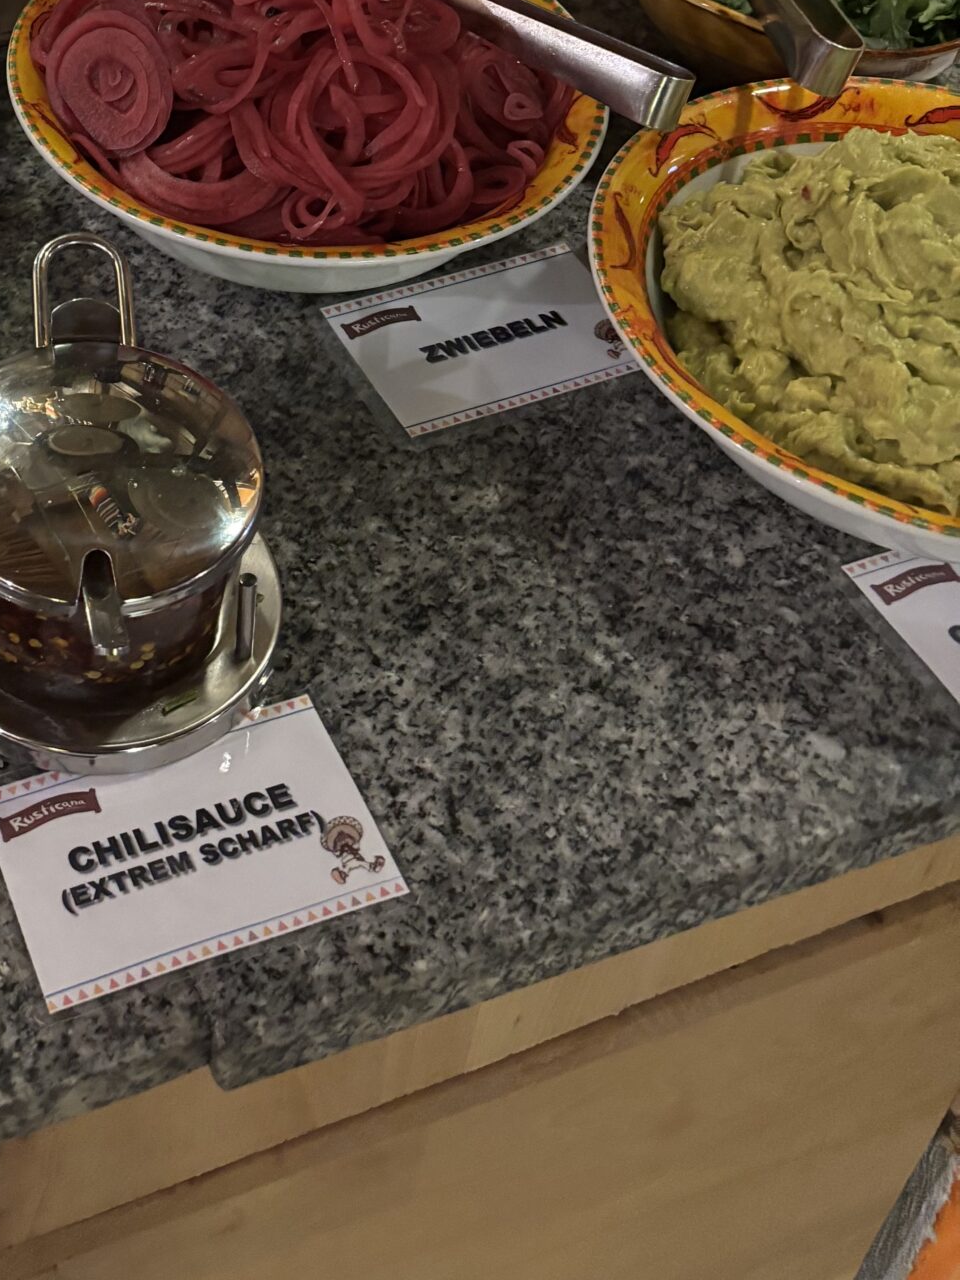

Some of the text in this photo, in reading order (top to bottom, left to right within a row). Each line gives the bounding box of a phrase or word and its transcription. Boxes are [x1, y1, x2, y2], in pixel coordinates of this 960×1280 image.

[418, 310, 569, 365] ZWIEBELN
[7, 798, 87, 833] Rusticana
[67, 783, 299, 874] CHILISAUCE
[61, 810, 326, 916] (EXTREM SCHARF)
